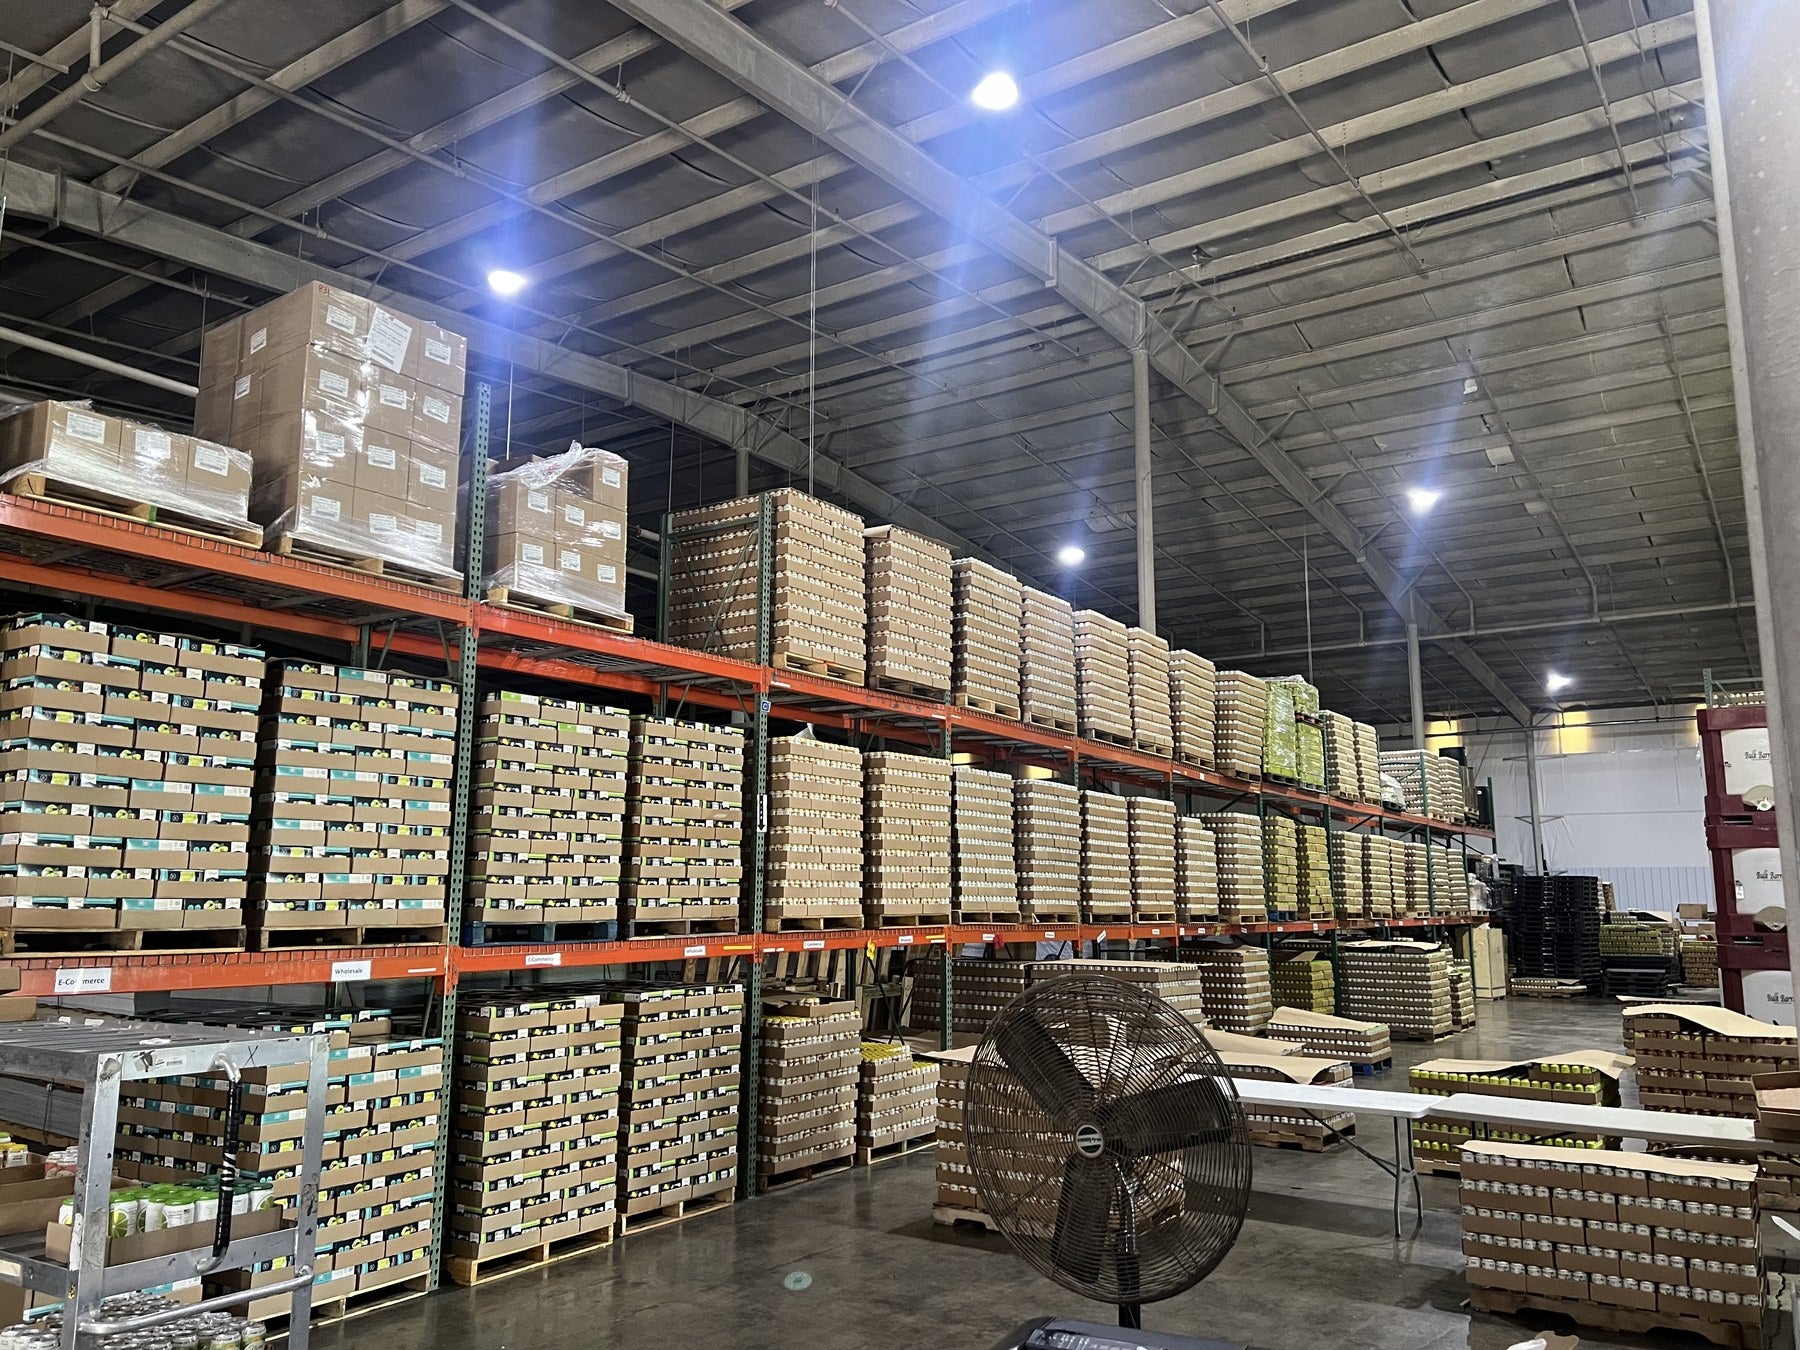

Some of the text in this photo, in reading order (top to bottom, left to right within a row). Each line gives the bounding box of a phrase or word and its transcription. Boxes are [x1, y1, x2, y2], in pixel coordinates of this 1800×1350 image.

[1758, 751, 1771, 759] Barr
[1770, 871, 1783, 879] Barr
[335, 967, 363, 975] Wholesale
[58, 978, 105, 986] E-Comerce
